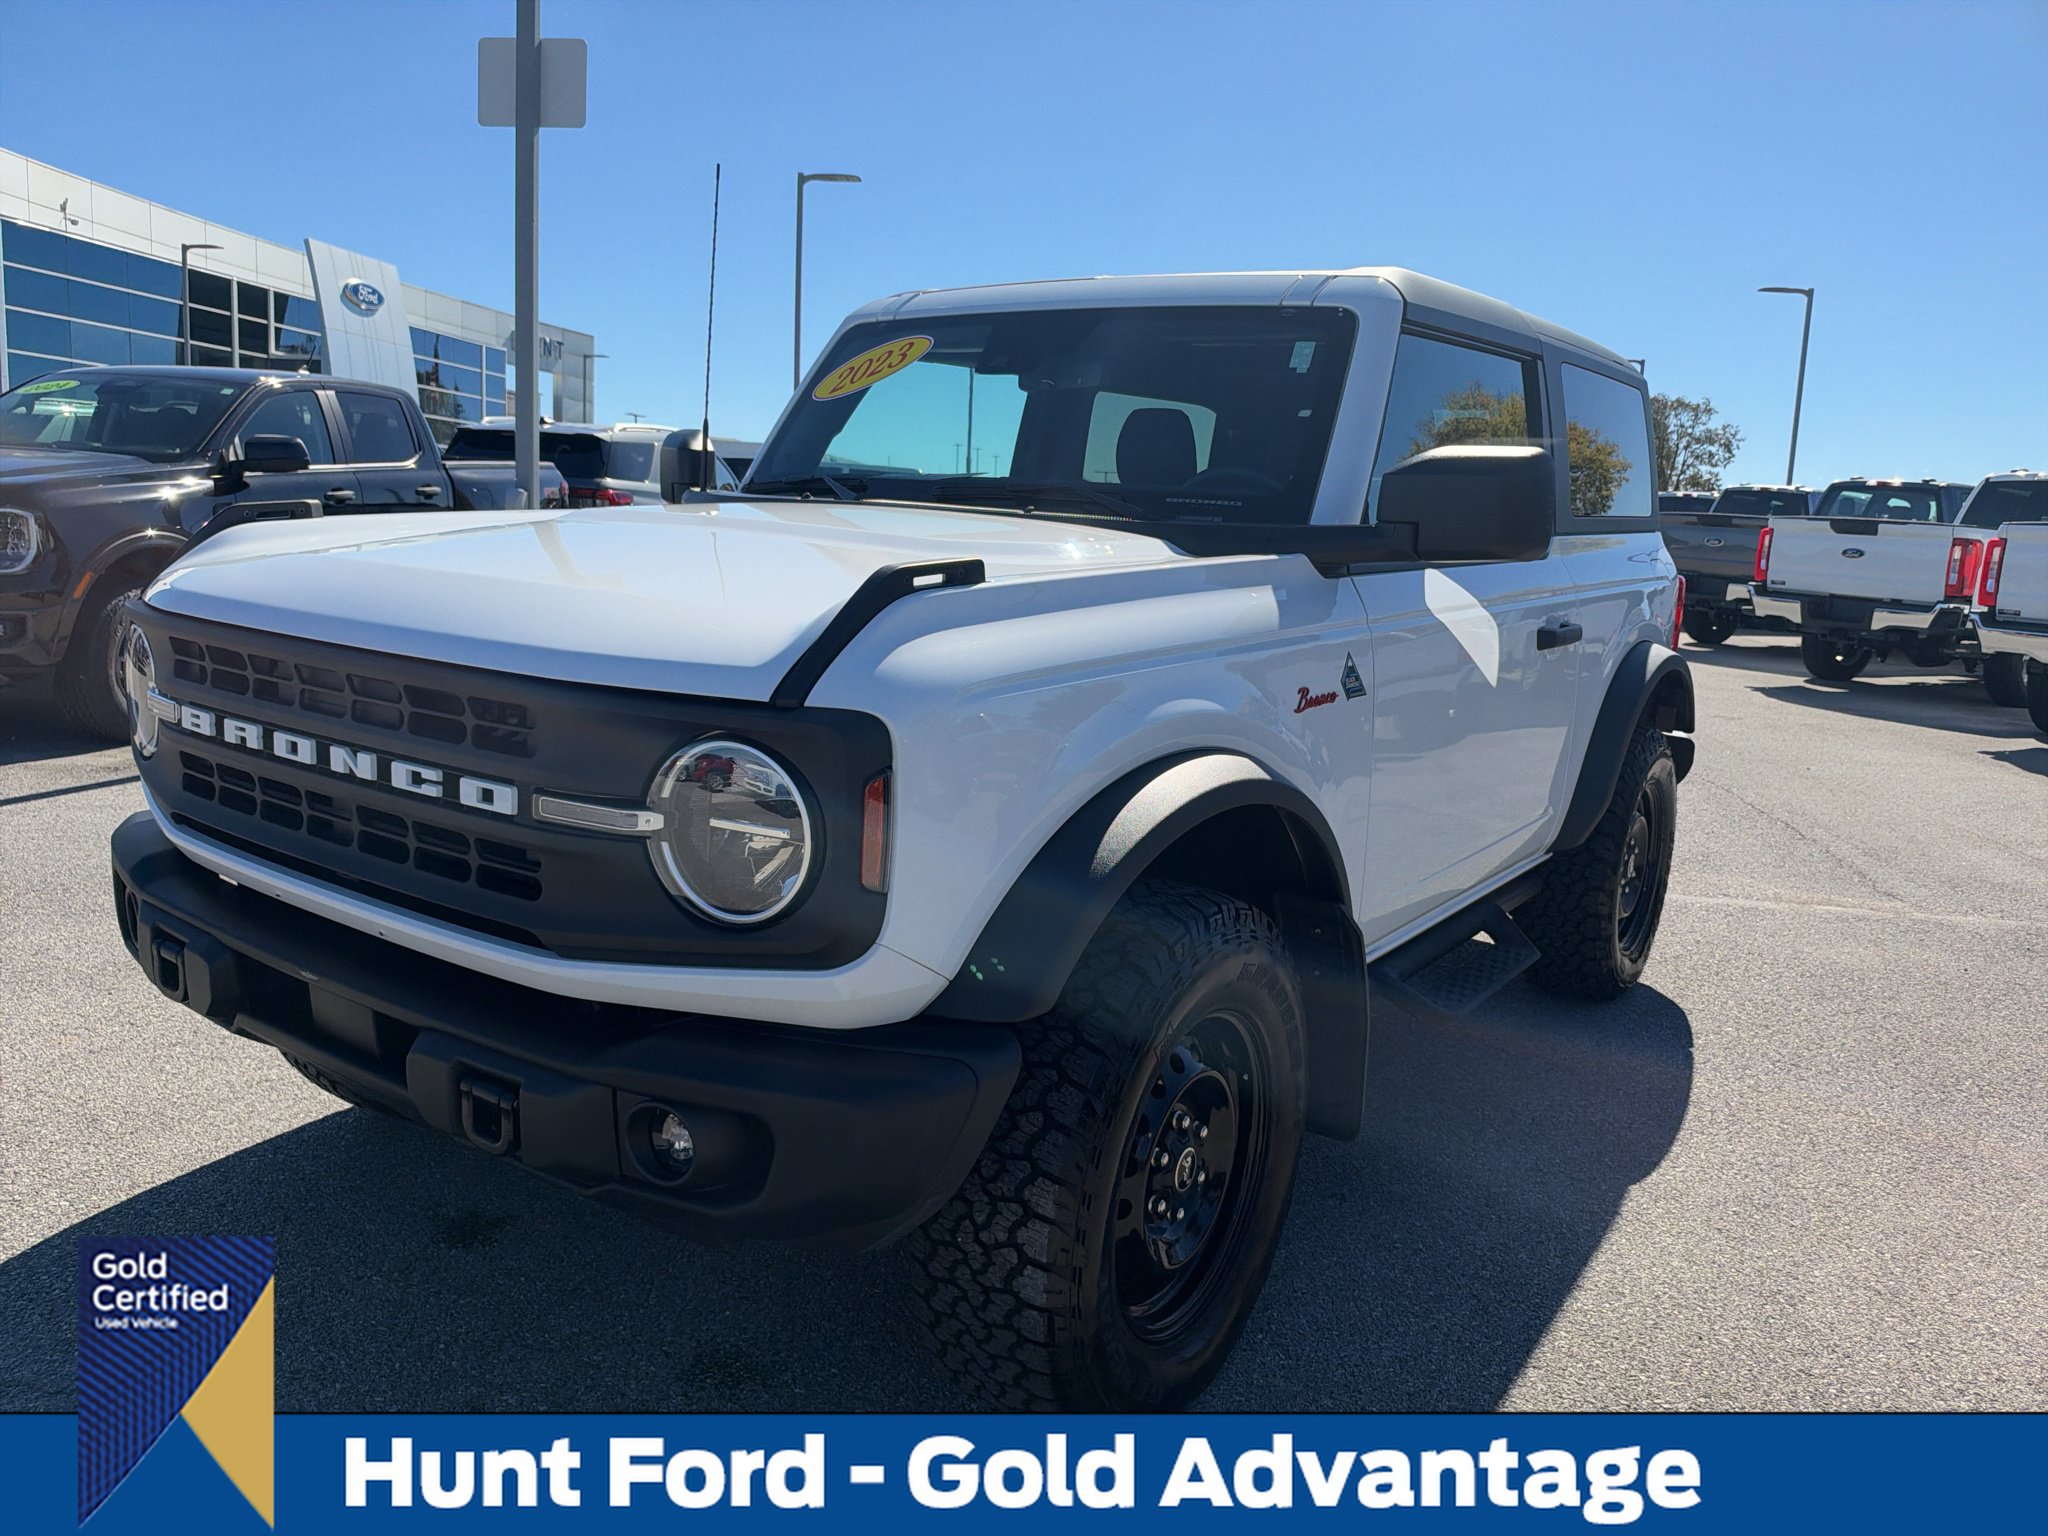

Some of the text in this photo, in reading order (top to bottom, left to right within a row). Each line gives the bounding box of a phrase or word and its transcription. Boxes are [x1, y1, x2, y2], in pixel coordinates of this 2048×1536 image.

[357, 283, 380, 305] Ford
[827, 341, 915, 395] 2023
[1294, 687, 1339, 713] Bronco
[180, 704, 518, 816] BRONCO
